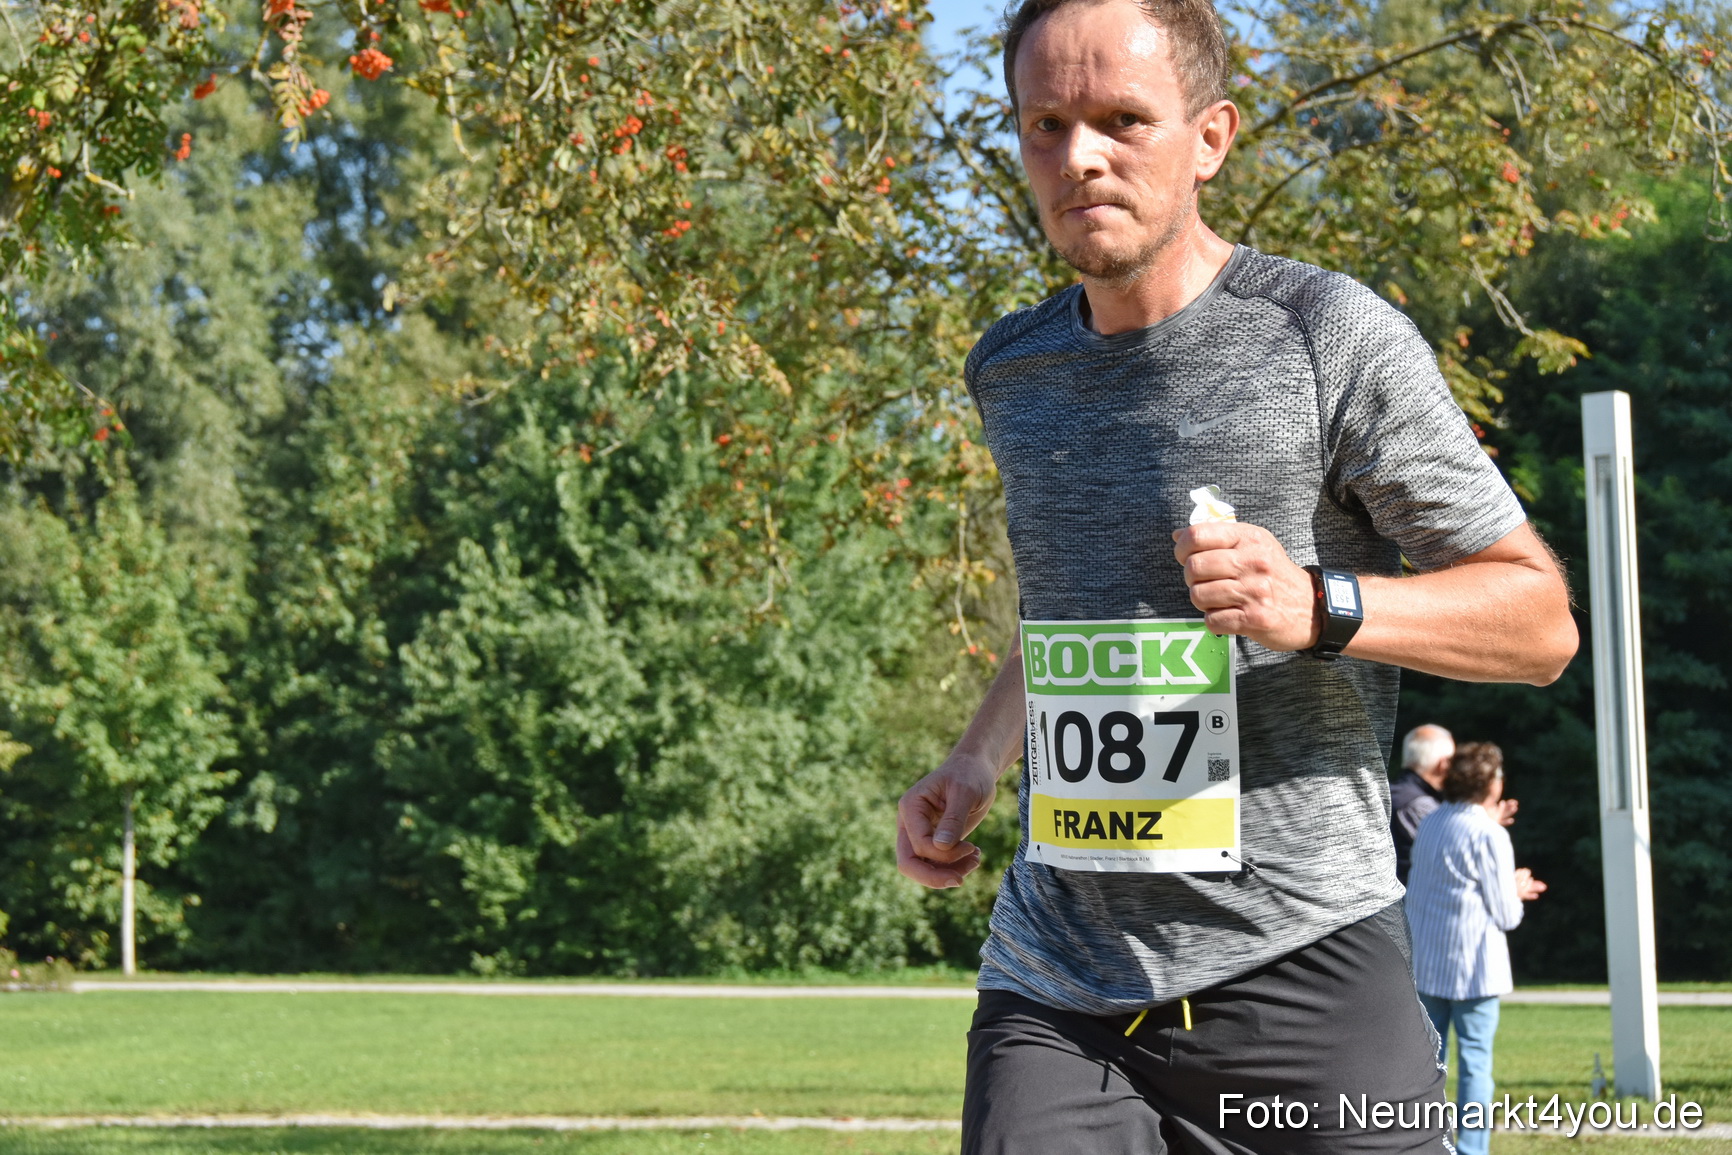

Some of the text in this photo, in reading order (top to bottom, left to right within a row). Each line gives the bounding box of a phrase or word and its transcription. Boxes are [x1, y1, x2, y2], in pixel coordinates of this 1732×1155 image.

[1028, 632, 1211, 686] BOCK
[1212, 716, 1224, 729] B
[1040, 710, 1200, 783] 1087
[1054, 809, 1163, 840] FRANZ
